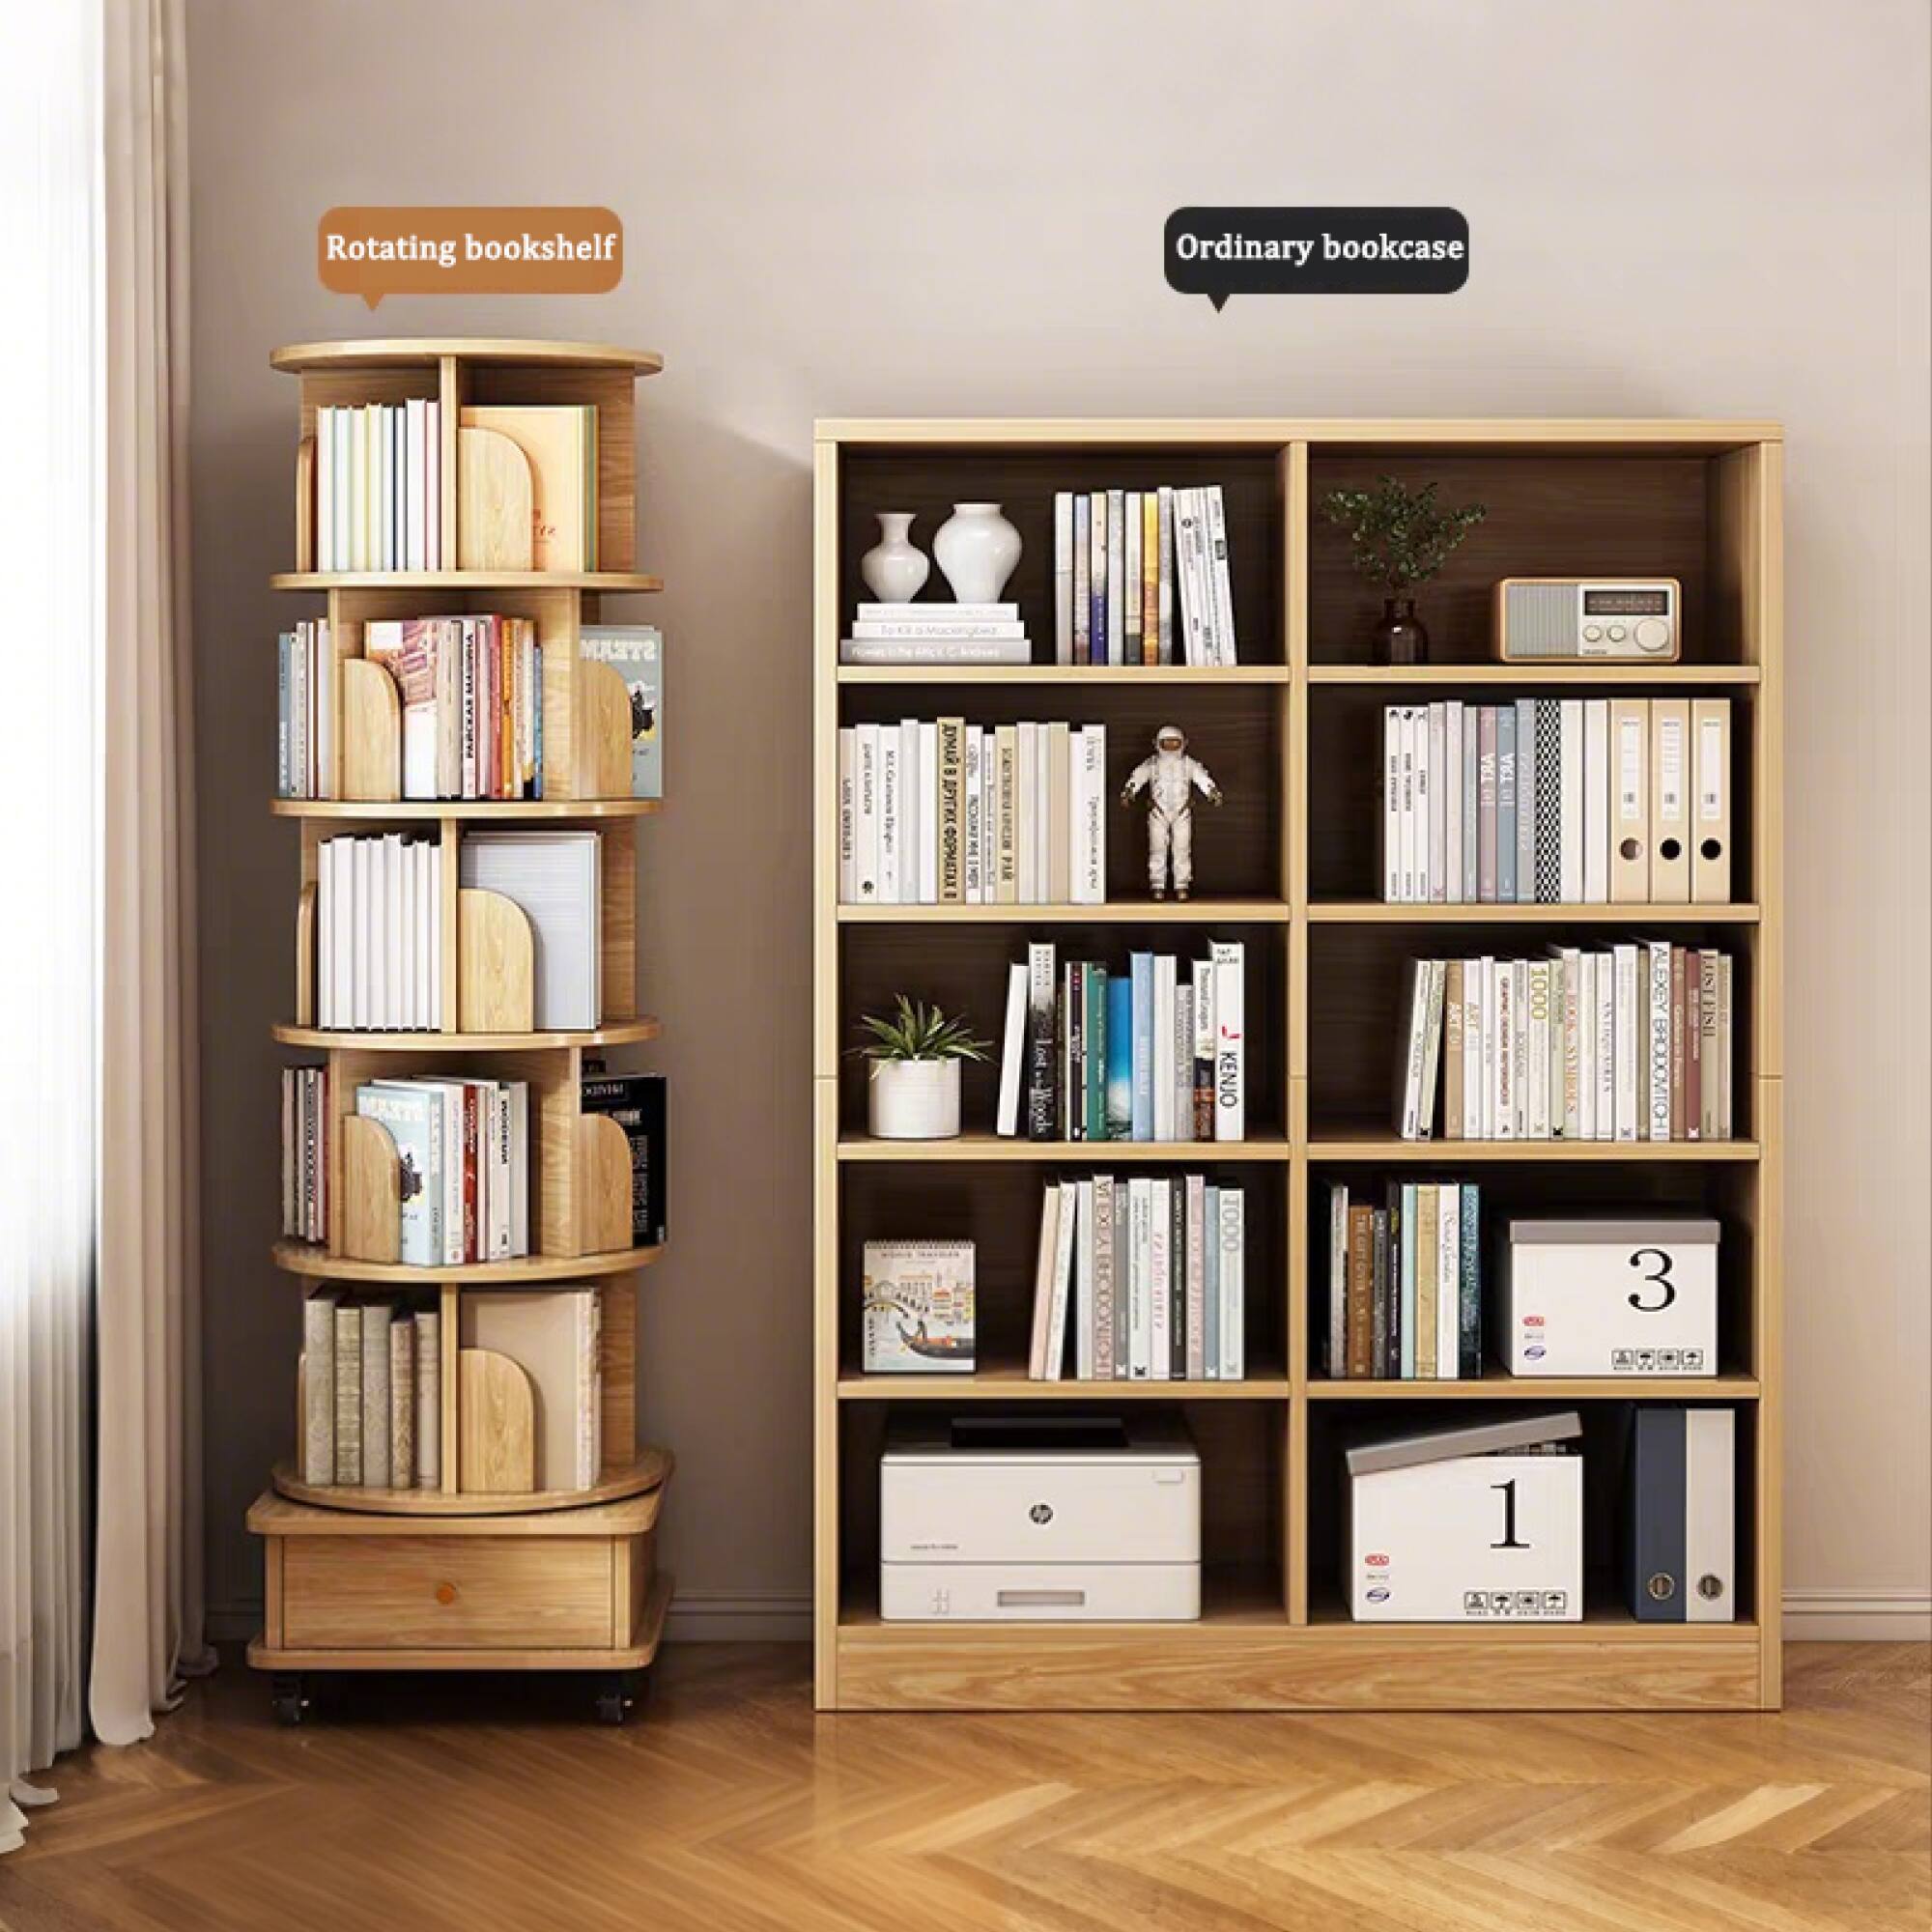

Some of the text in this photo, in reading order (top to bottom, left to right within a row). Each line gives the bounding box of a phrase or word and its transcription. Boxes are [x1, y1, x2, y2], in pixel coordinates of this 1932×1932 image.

[1530, 968, 1548, 1020] 1000
[1219, 1051, 1237, 1108] KENJO
[1627, 1247, 1676, 1313] 3
[1490, 1477, 1531, 1549] 1
